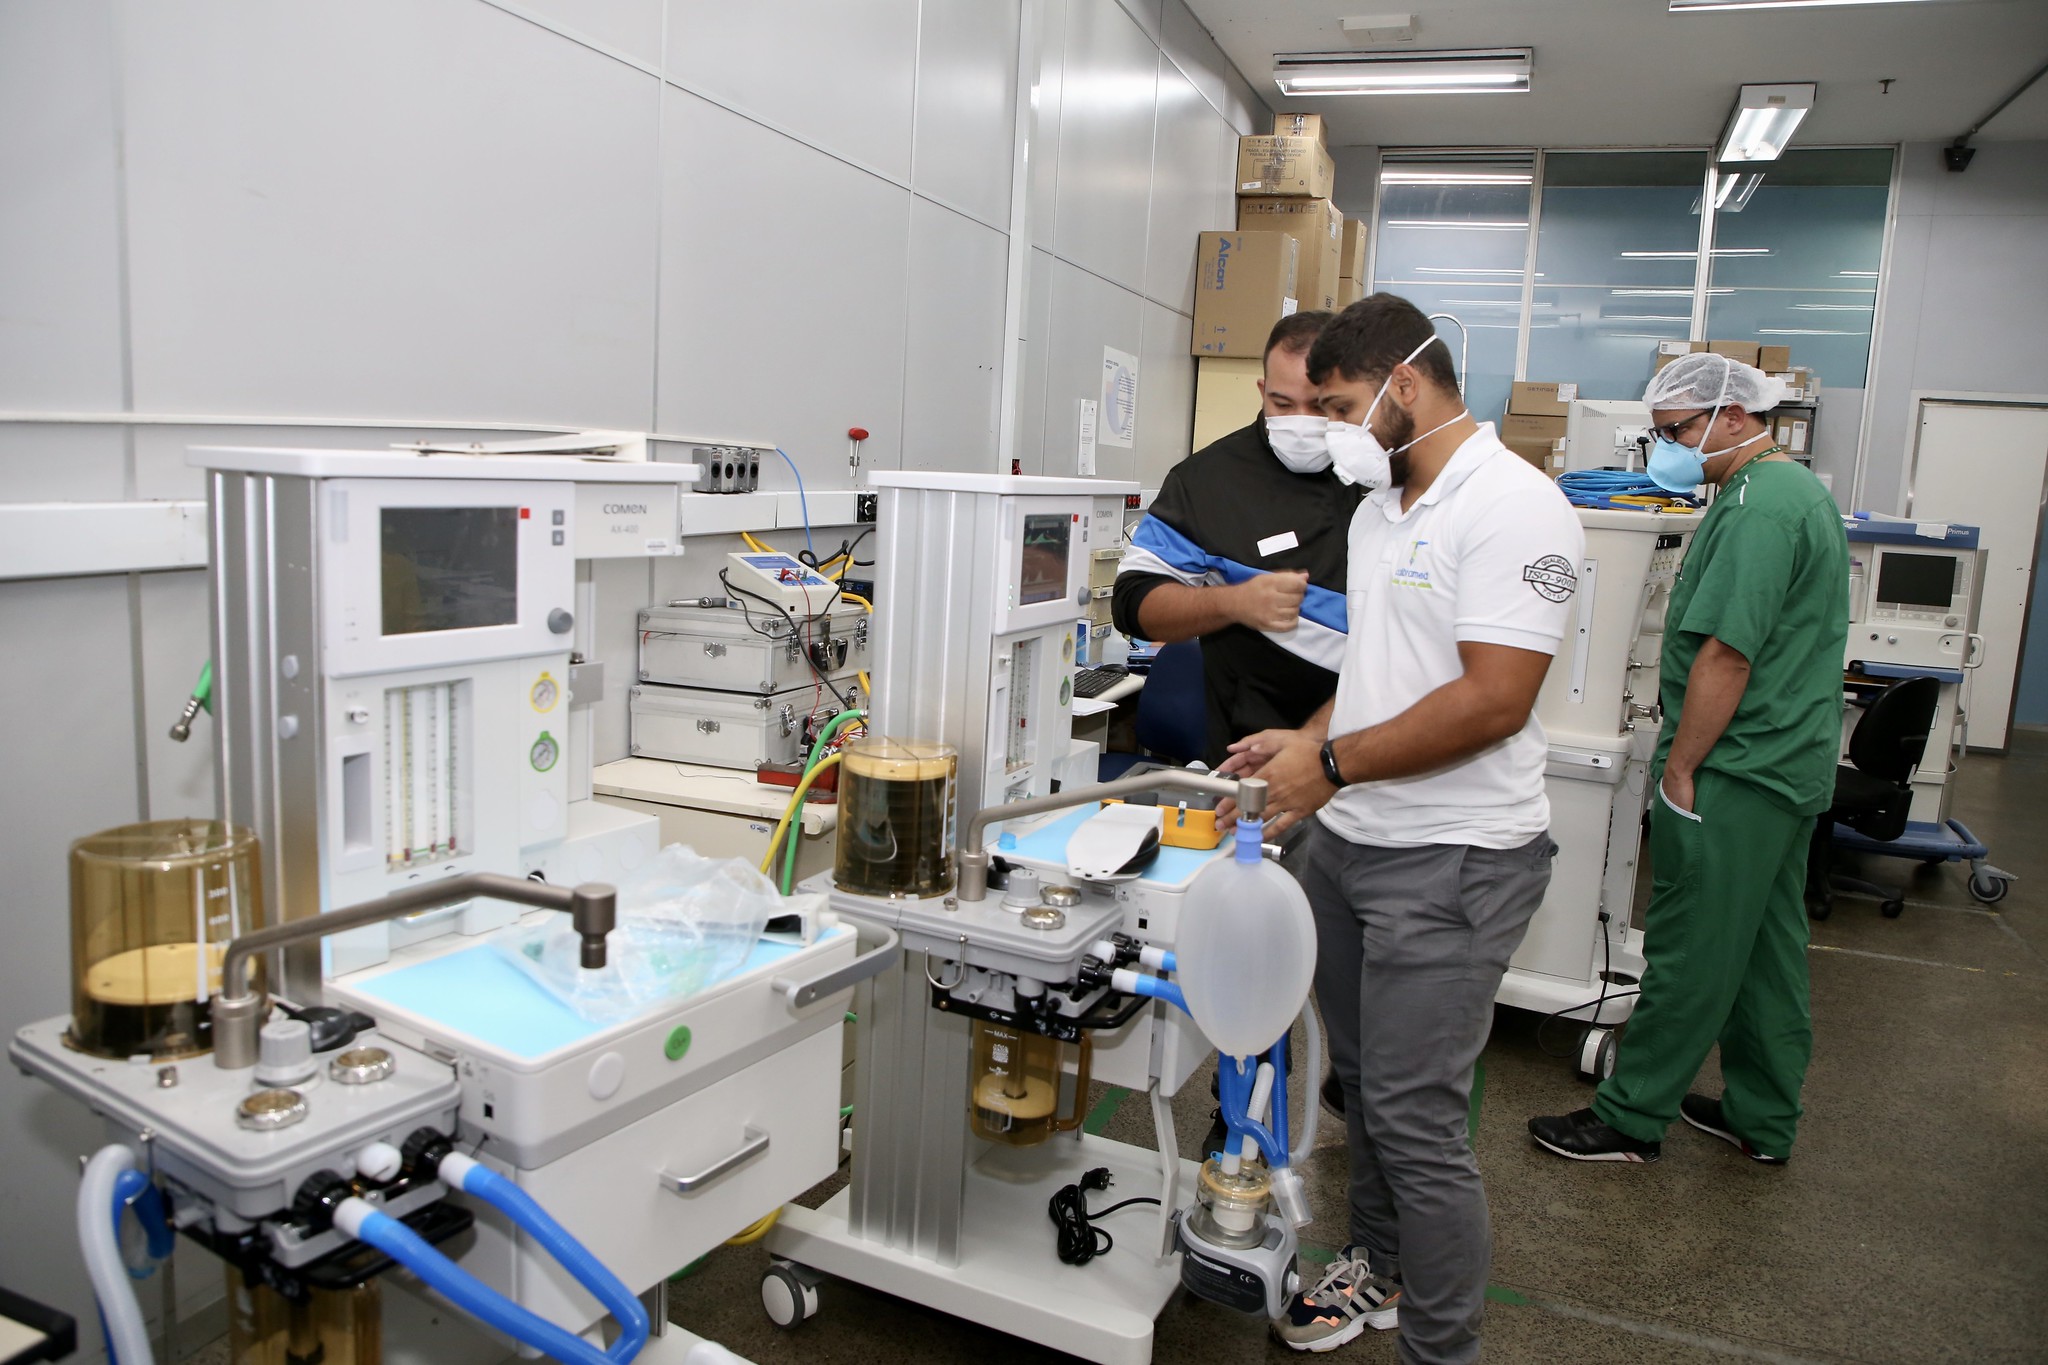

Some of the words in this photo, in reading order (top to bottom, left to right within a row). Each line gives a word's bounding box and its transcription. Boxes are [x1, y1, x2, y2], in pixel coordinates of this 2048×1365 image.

[1216, 237, 1232, 291] Alcon
[1947, 527, 1970, 536] Primus
[993, 1029, 1009, 1040] MAX
